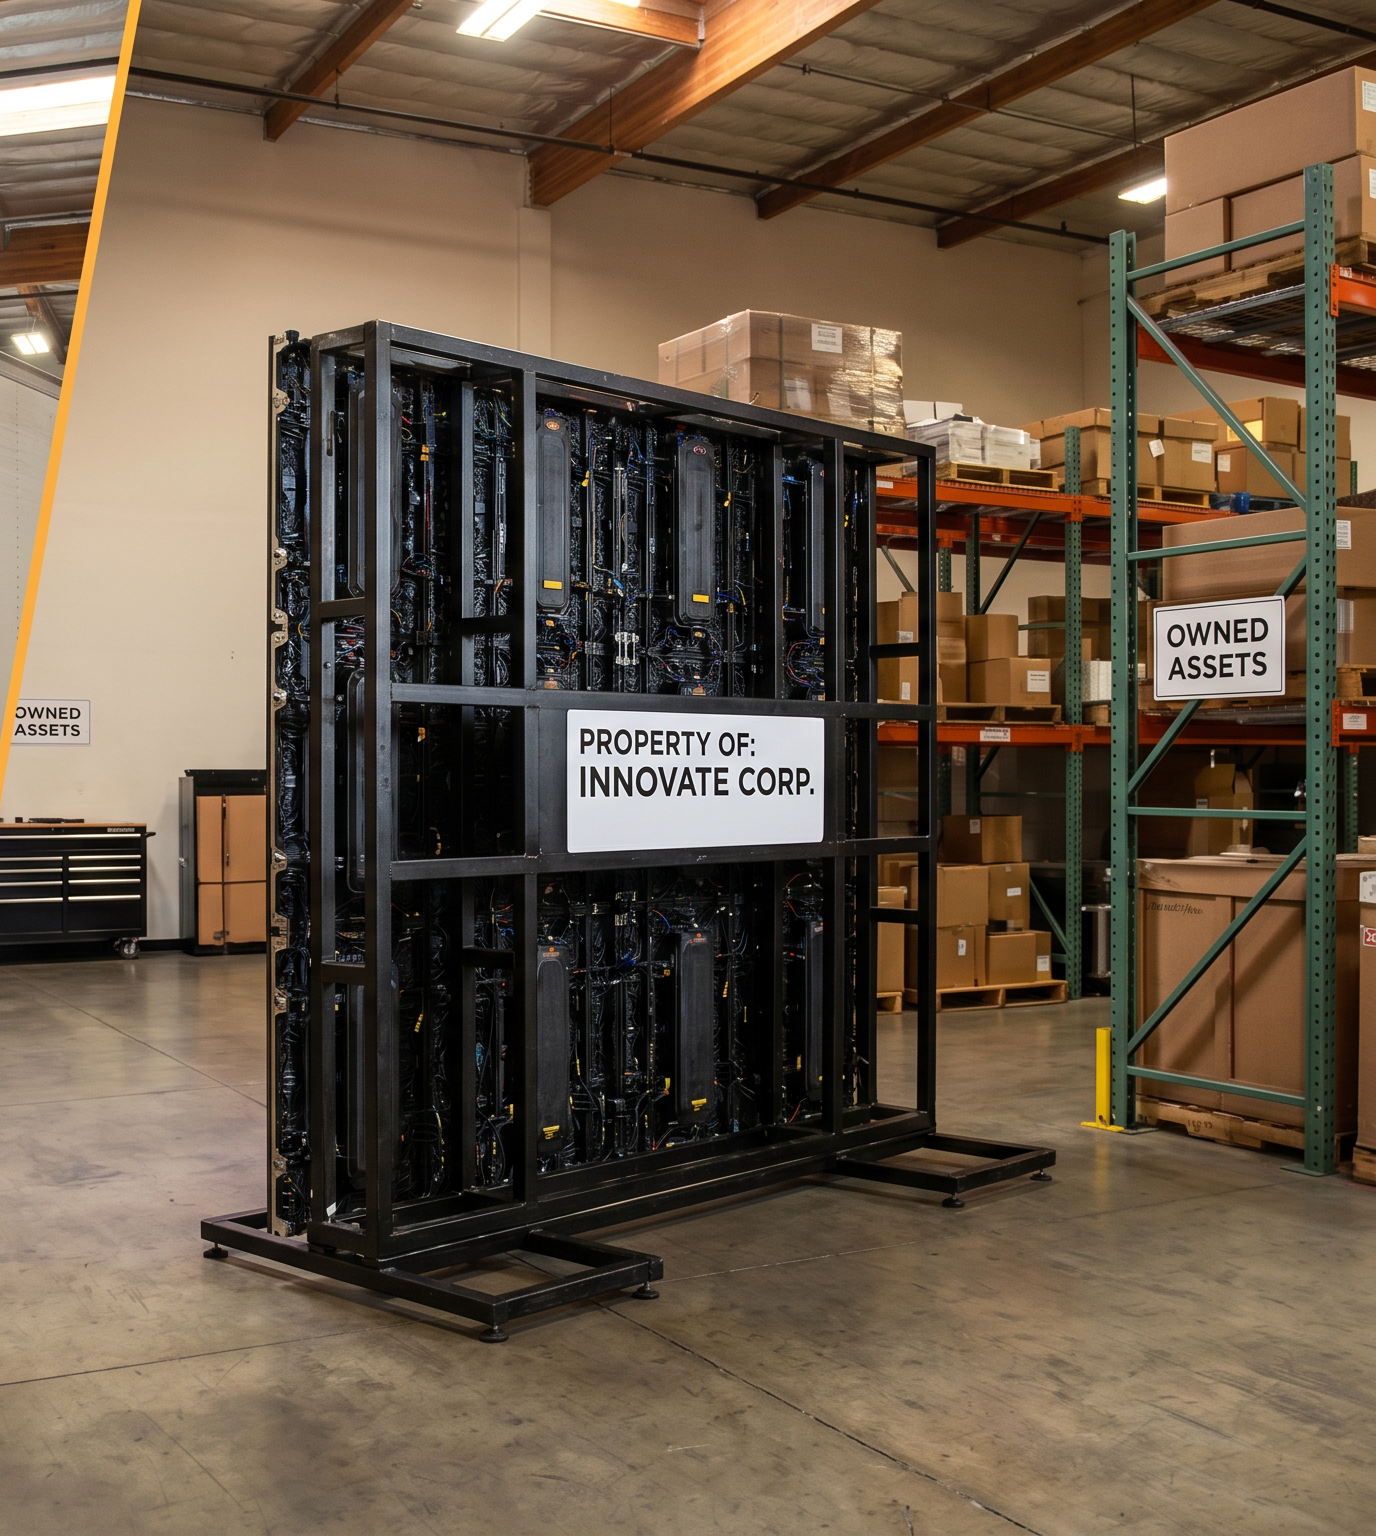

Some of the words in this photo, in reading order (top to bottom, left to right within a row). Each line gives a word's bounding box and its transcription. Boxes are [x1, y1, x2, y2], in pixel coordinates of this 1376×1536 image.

[1166, 617, 1269, 648] OWNED
[1168, 651, 1268, 681] ASSETS
[15, 706, 81, 720] OWNED
[14, 723, 81, 737] ASSETS
[580, 728, 712, 756] PROPERTY
[718, 731, 755, 757] OF:
[580, 765, 729, 798] INNOVATE
[738, 766, 815, 796] CORP.
